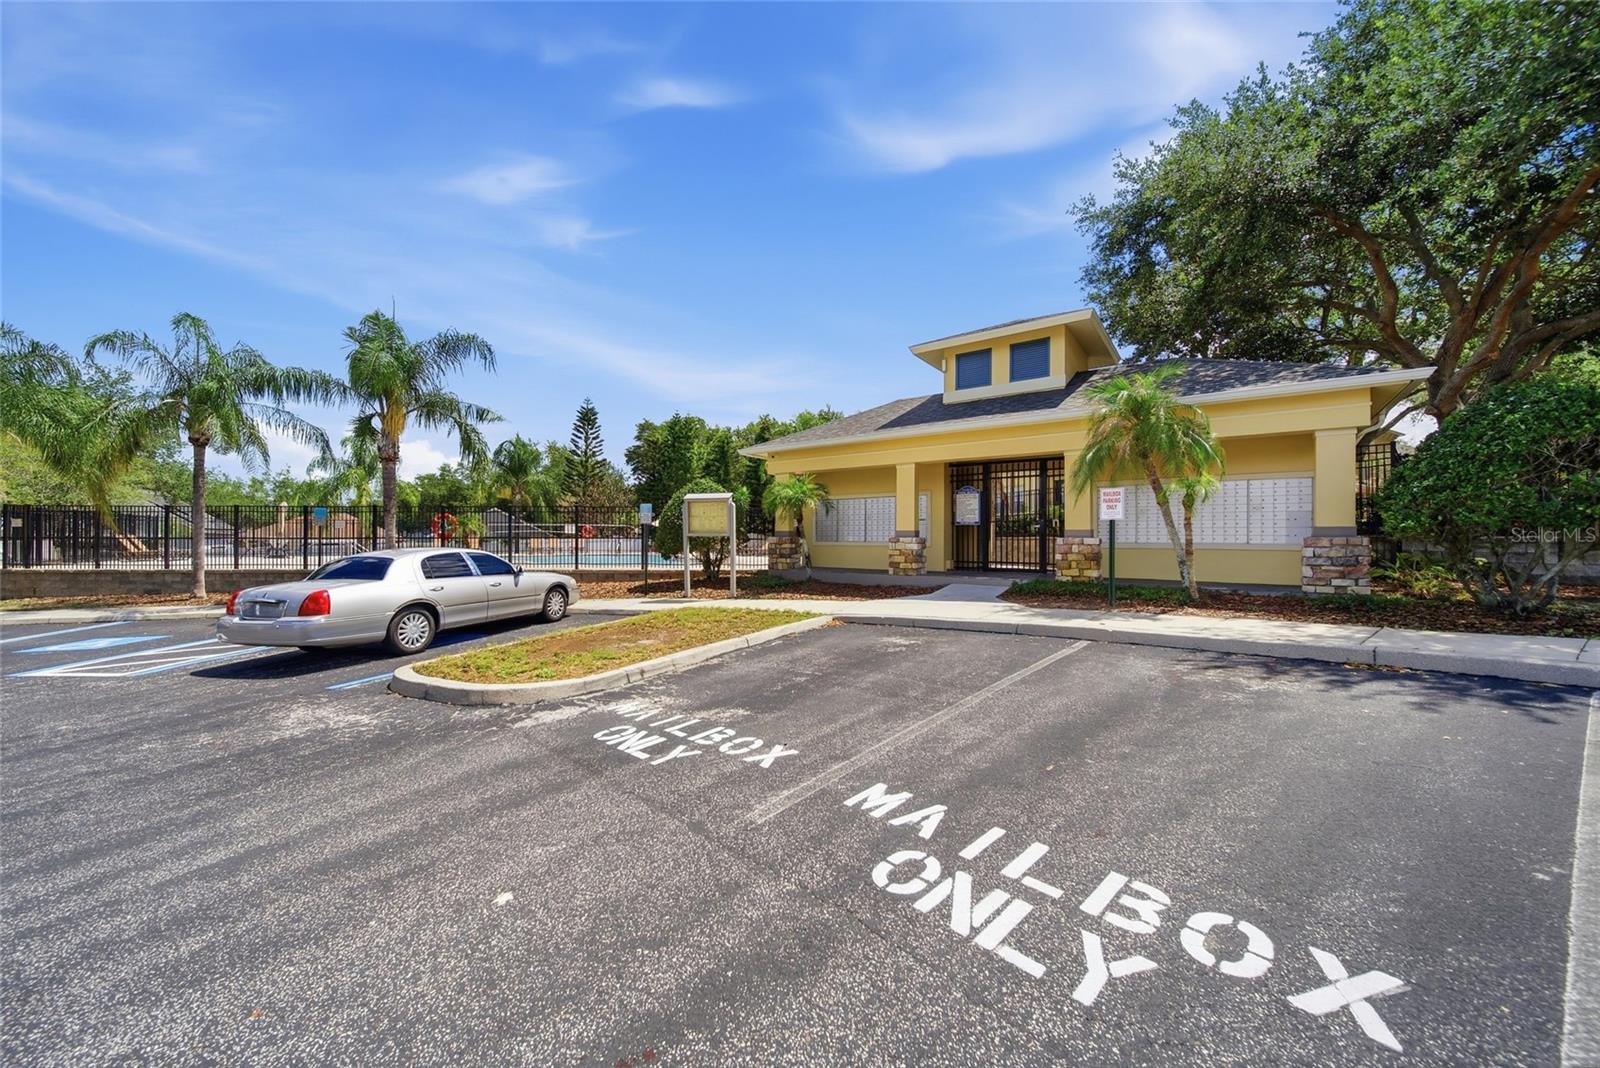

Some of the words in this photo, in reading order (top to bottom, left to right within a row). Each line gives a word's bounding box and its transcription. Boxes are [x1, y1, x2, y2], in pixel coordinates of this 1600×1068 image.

[593, 725, 702, 765] ONLY
[607, 702, 799, 768] MAILBOX
[843, 782, 1411, 1052] MAILBOX
[871, 850, 1158, 1006] ONLY
